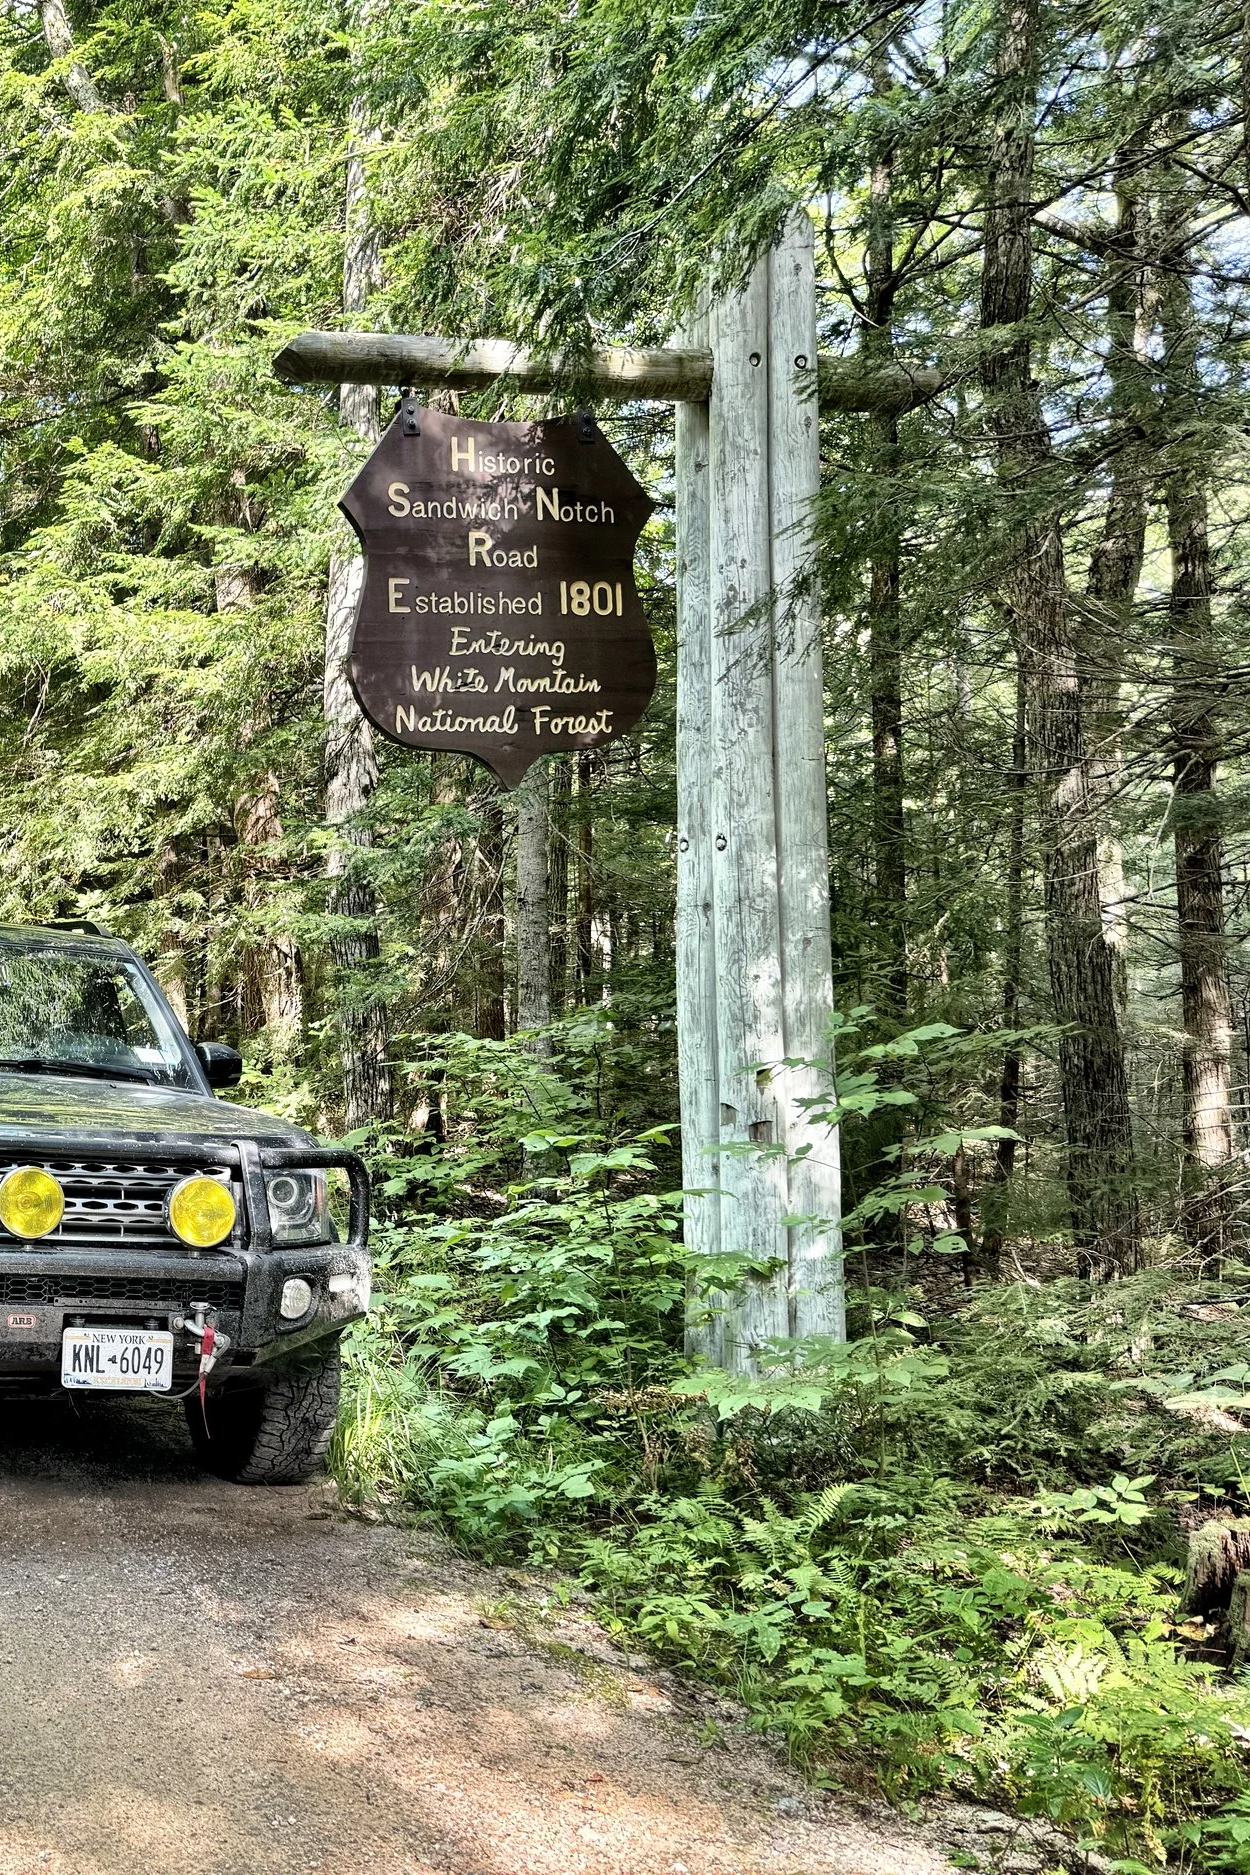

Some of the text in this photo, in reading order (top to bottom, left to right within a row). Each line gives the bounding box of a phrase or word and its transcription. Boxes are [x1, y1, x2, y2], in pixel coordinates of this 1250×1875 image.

[450, 436, 556, 476] Historic
[387, 481, 615, 524] Sandwich Notch
[468, 531, 538, 569] Road
[388, 577, 623, 617] Established 1801
[449, 626, 566, 666] Entering
[411, 665, 602, 694] White Mountain
[395, 704, 614, 736] National Forest
[11, 1317, 32, 1325] ARB
[92, 1333, 146, 1345] NEW YORK
[72, 1344, 165, 1376] KNL 6049
